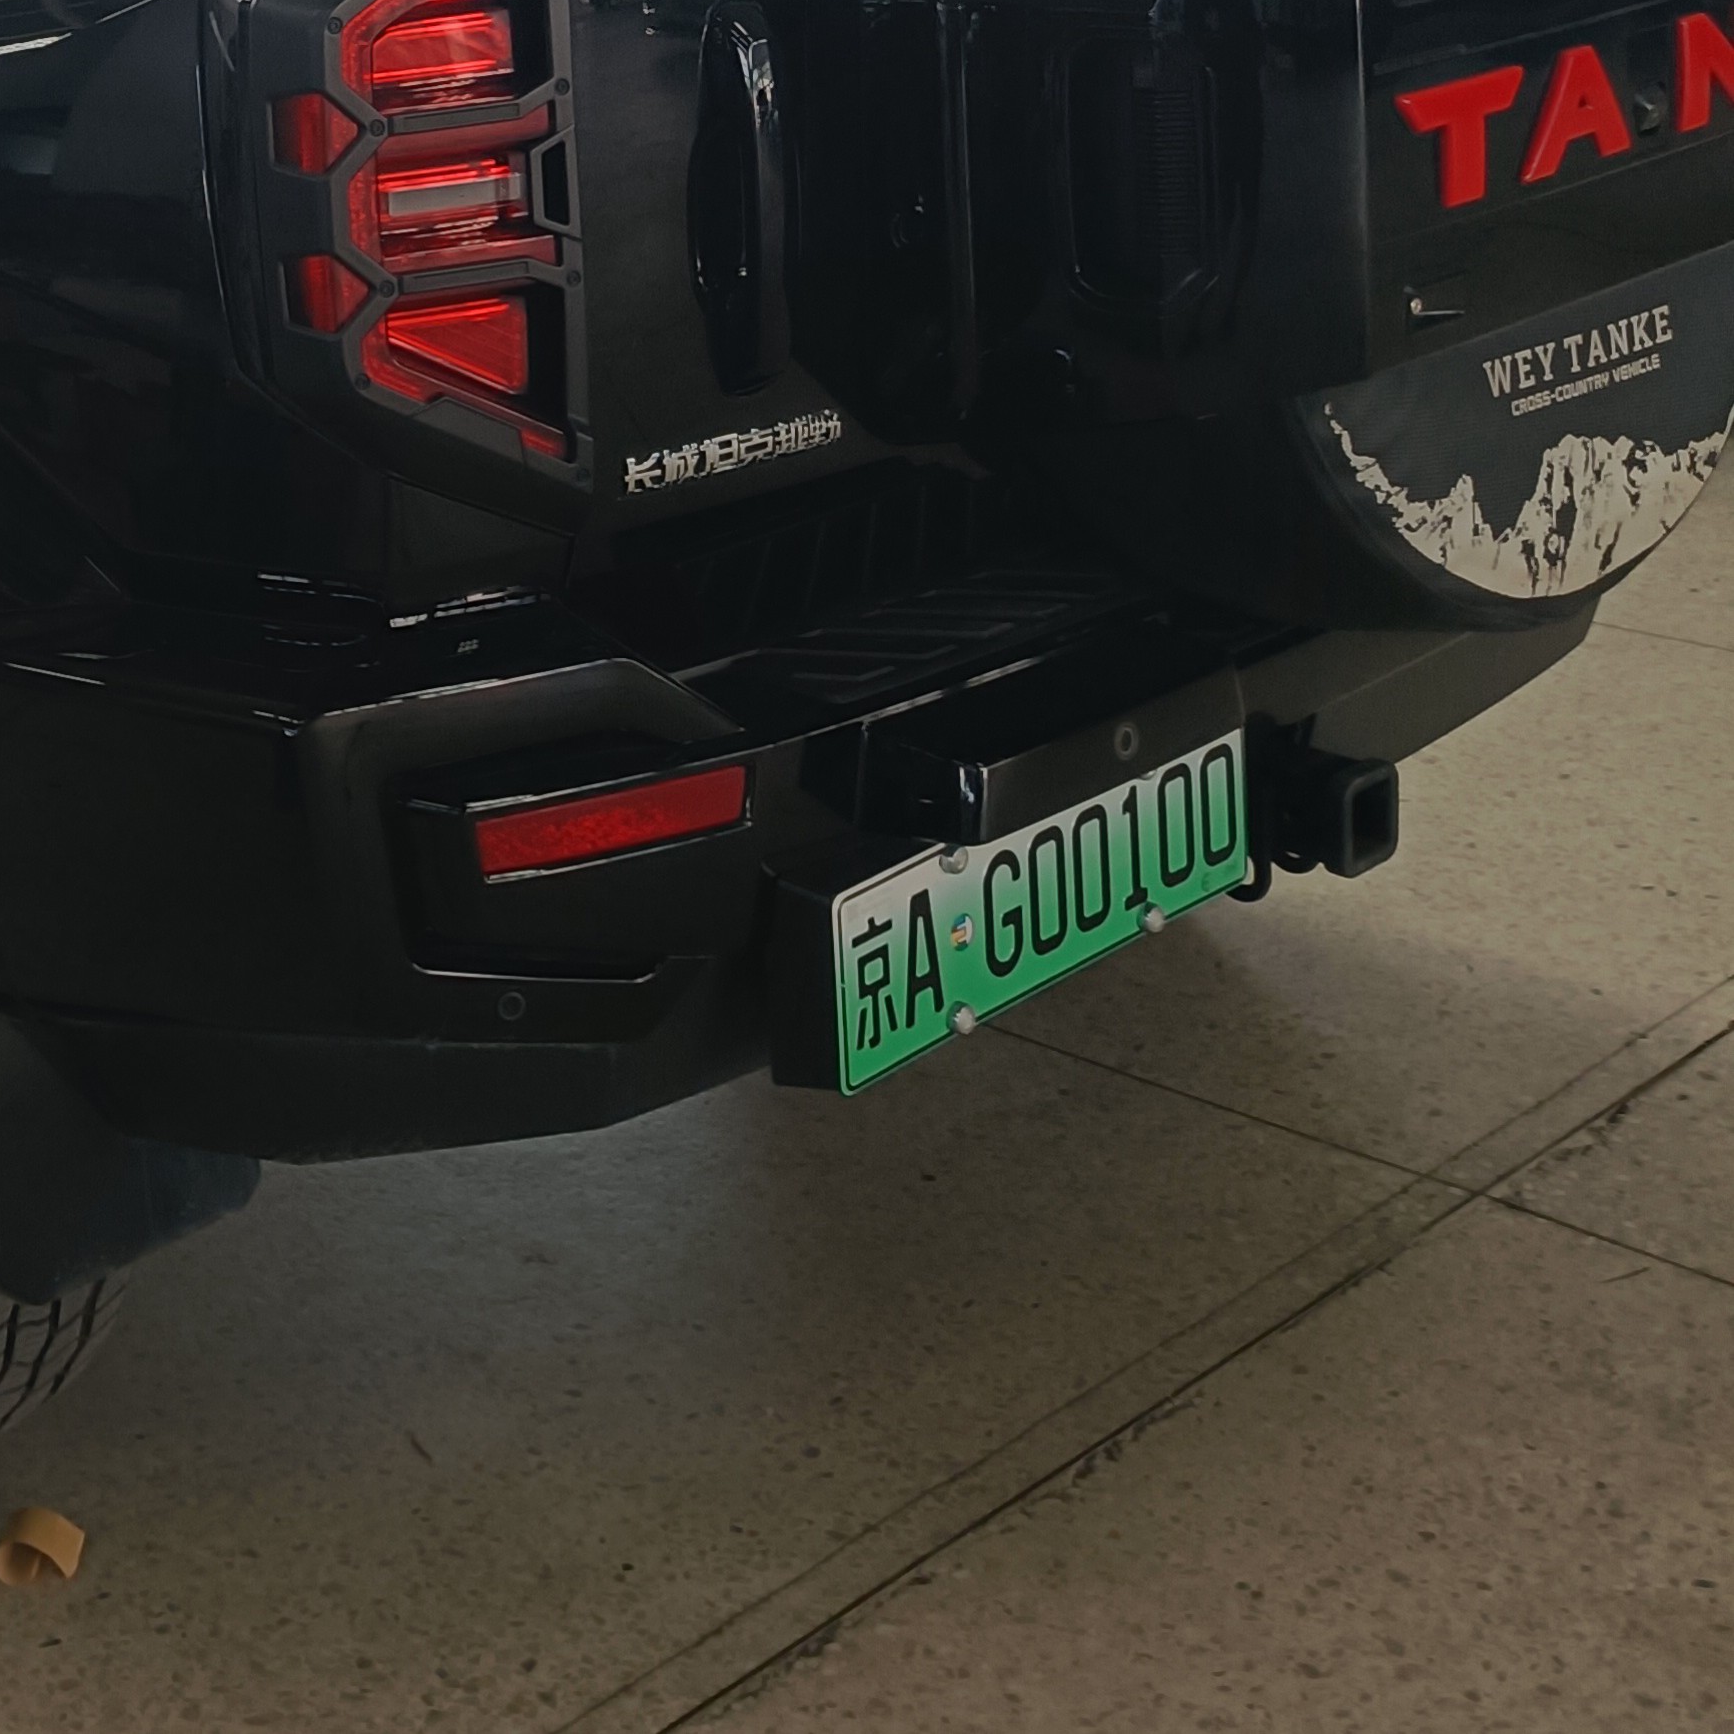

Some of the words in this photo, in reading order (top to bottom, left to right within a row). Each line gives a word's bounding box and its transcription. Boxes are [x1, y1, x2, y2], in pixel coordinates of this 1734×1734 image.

[1482, 342, 1557, 398] WEY
[1563, 304, 1674, 374] TANKE
[1510, 371, 1611, 417] CROSS-COUNTRY
[1612, 353, 1662, 383] VEHICLE
